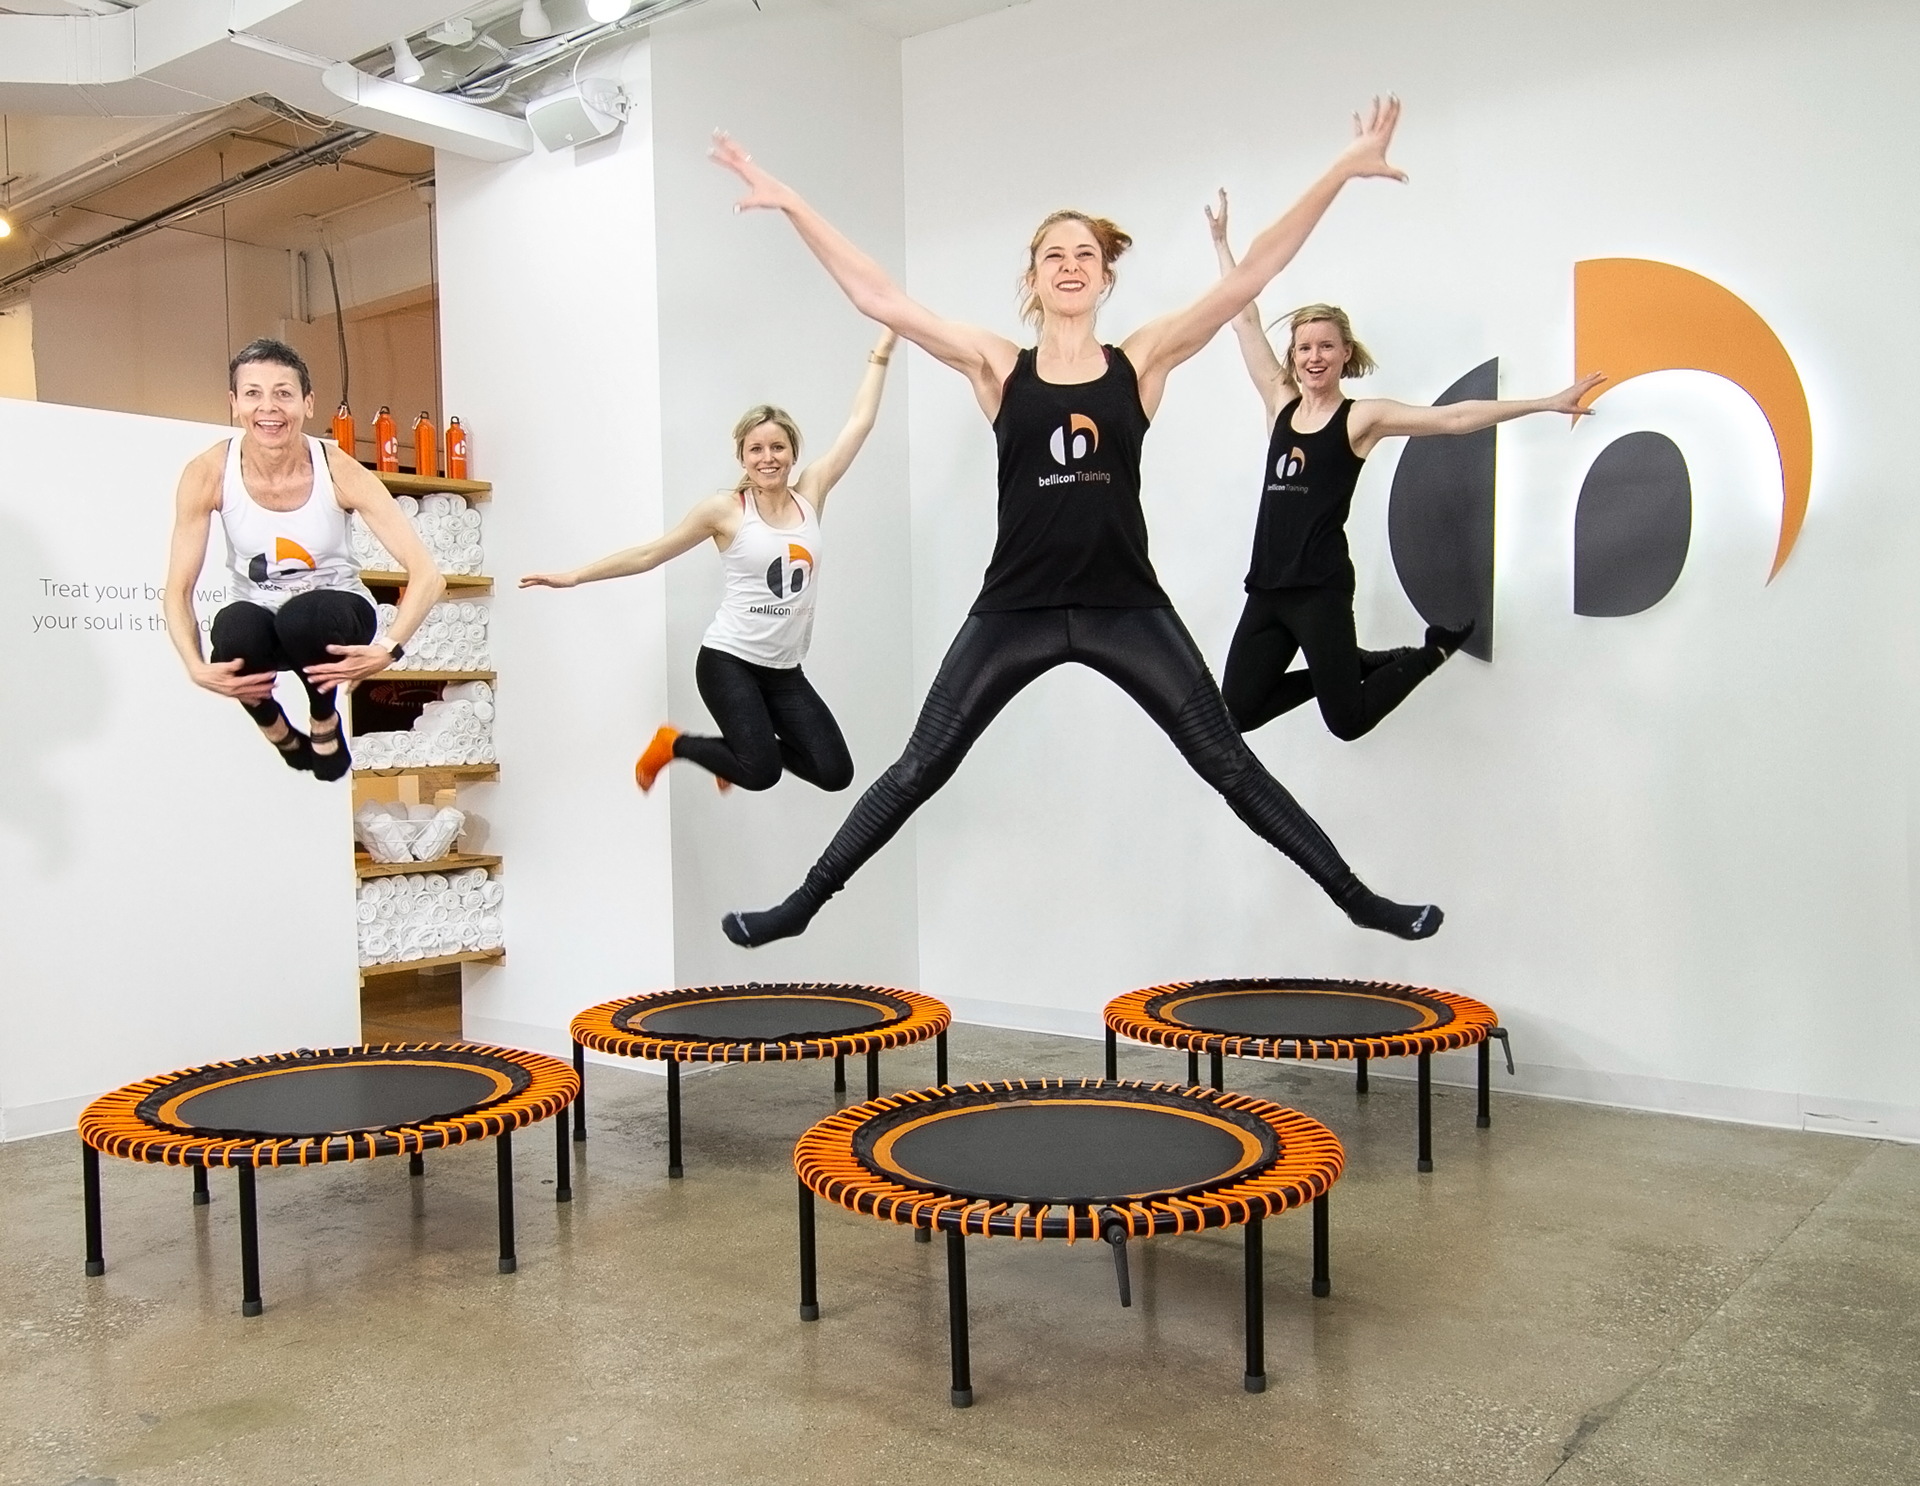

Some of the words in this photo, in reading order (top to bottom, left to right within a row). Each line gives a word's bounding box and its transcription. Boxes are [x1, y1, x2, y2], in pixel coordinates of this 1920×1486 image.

[1038, 473, 1075, 487] bellicon
[1075, 471, 1111, 484] Training
[39, 577, 90, 598] Treat
[94, 585, 139, 604] your
[144, 582, 167, 601] bo
[196, 586, 227, 603] wel
[32, 614, 78, 634] your
[84, 612, 123, 631] soul
[129, 613, 143, 631] is
[148, 613, 168, 632] th
